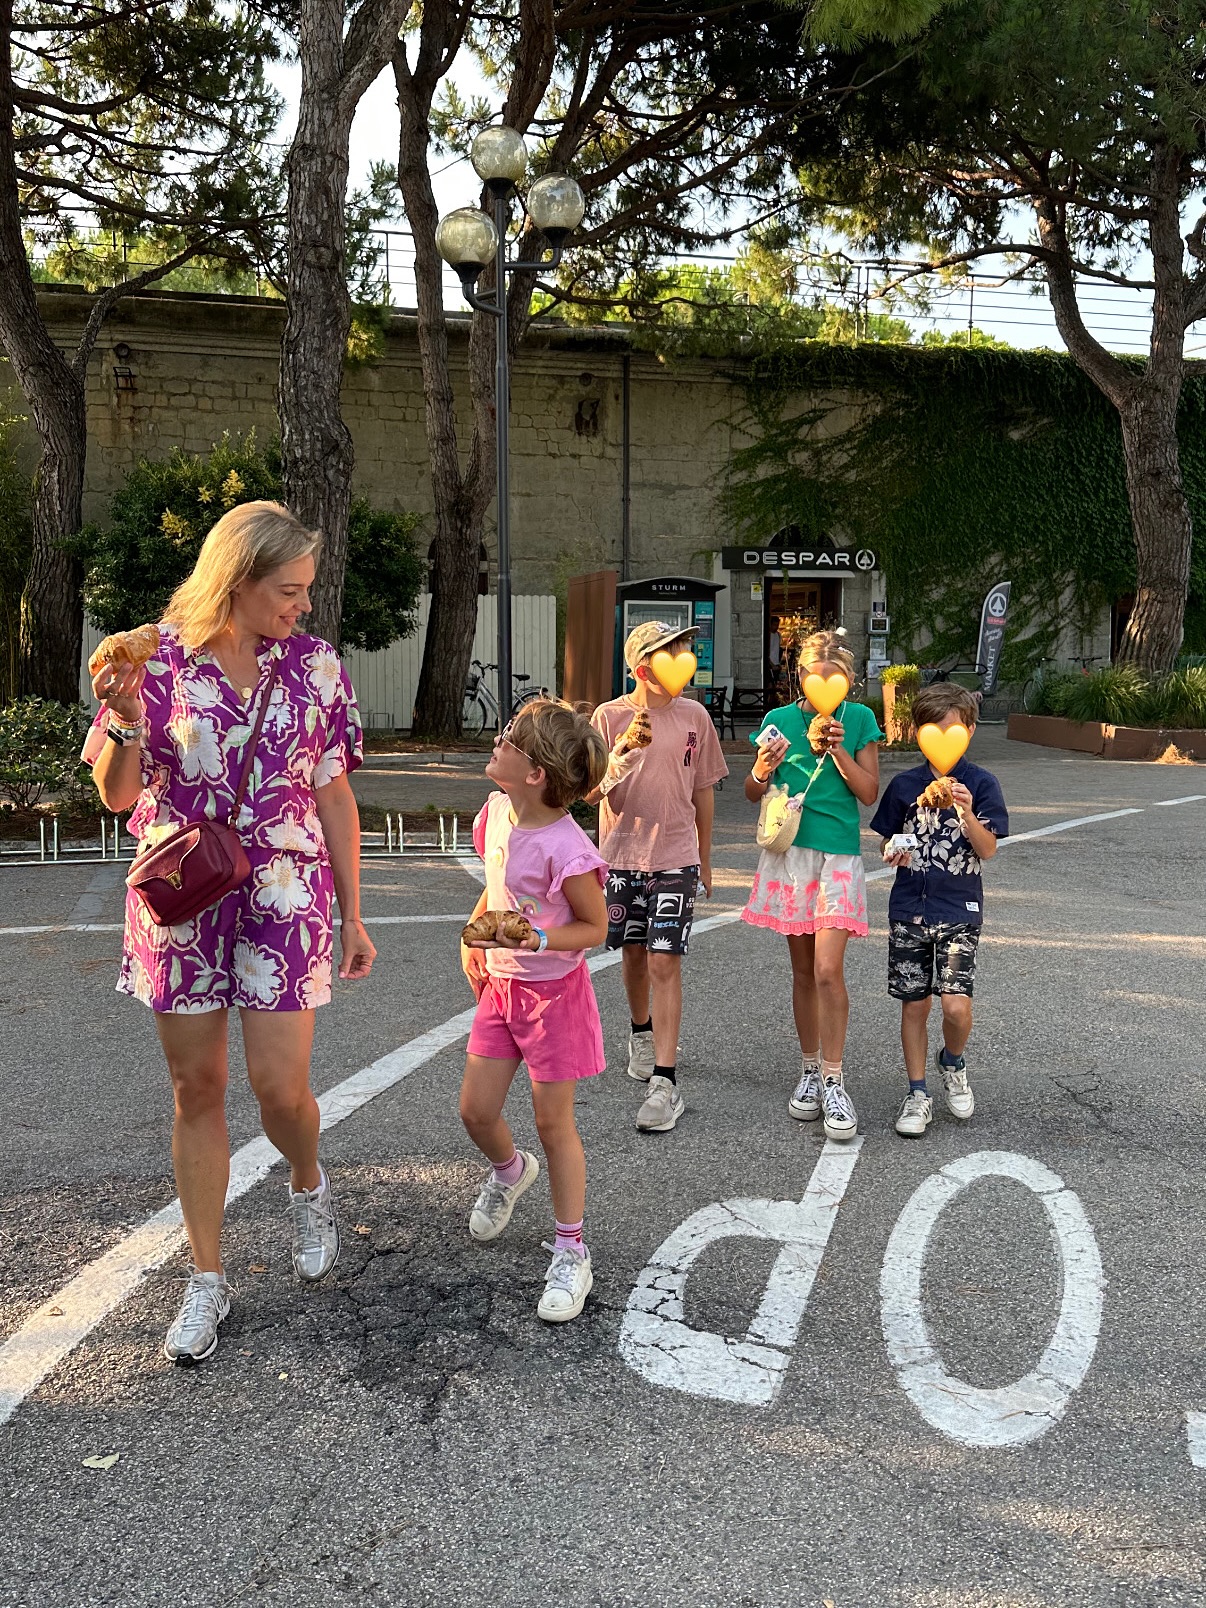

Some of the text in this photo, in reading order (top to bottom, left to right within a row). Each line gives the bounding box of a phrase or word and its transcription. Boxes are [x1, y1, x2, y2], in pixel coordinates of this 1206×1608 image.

[743, 551, 850, 566] DESPAR
[984, 645, 996, 692] MARKET
[620, 1134, 1206, 1468] OP
